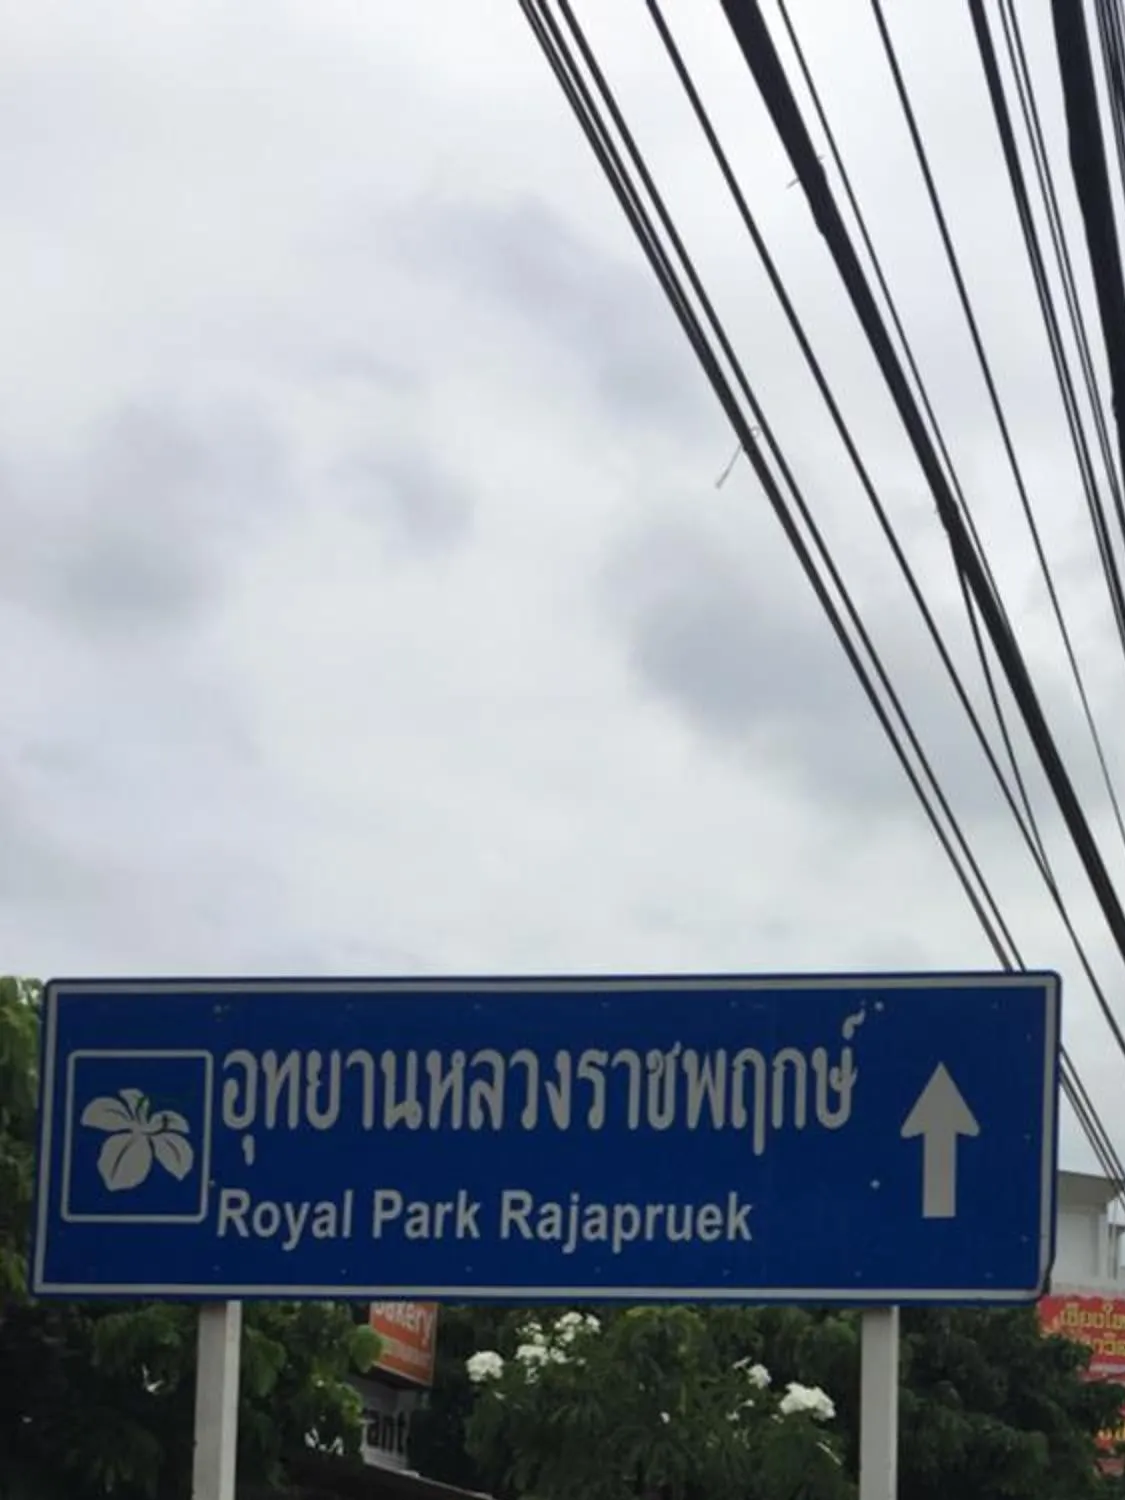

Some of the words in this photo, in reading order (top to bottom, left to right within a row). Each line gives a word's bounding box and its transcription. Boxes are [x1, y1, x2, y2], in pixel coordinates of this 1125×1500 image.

[222, 1011, 864, 1165] อุทยานหลวงราชพฤกษ์
[217, 1189, 352, 1250] Royal
[372, 1189, 481, 1240] Park
[501, 1190, 752, 1253] Rajapruek
